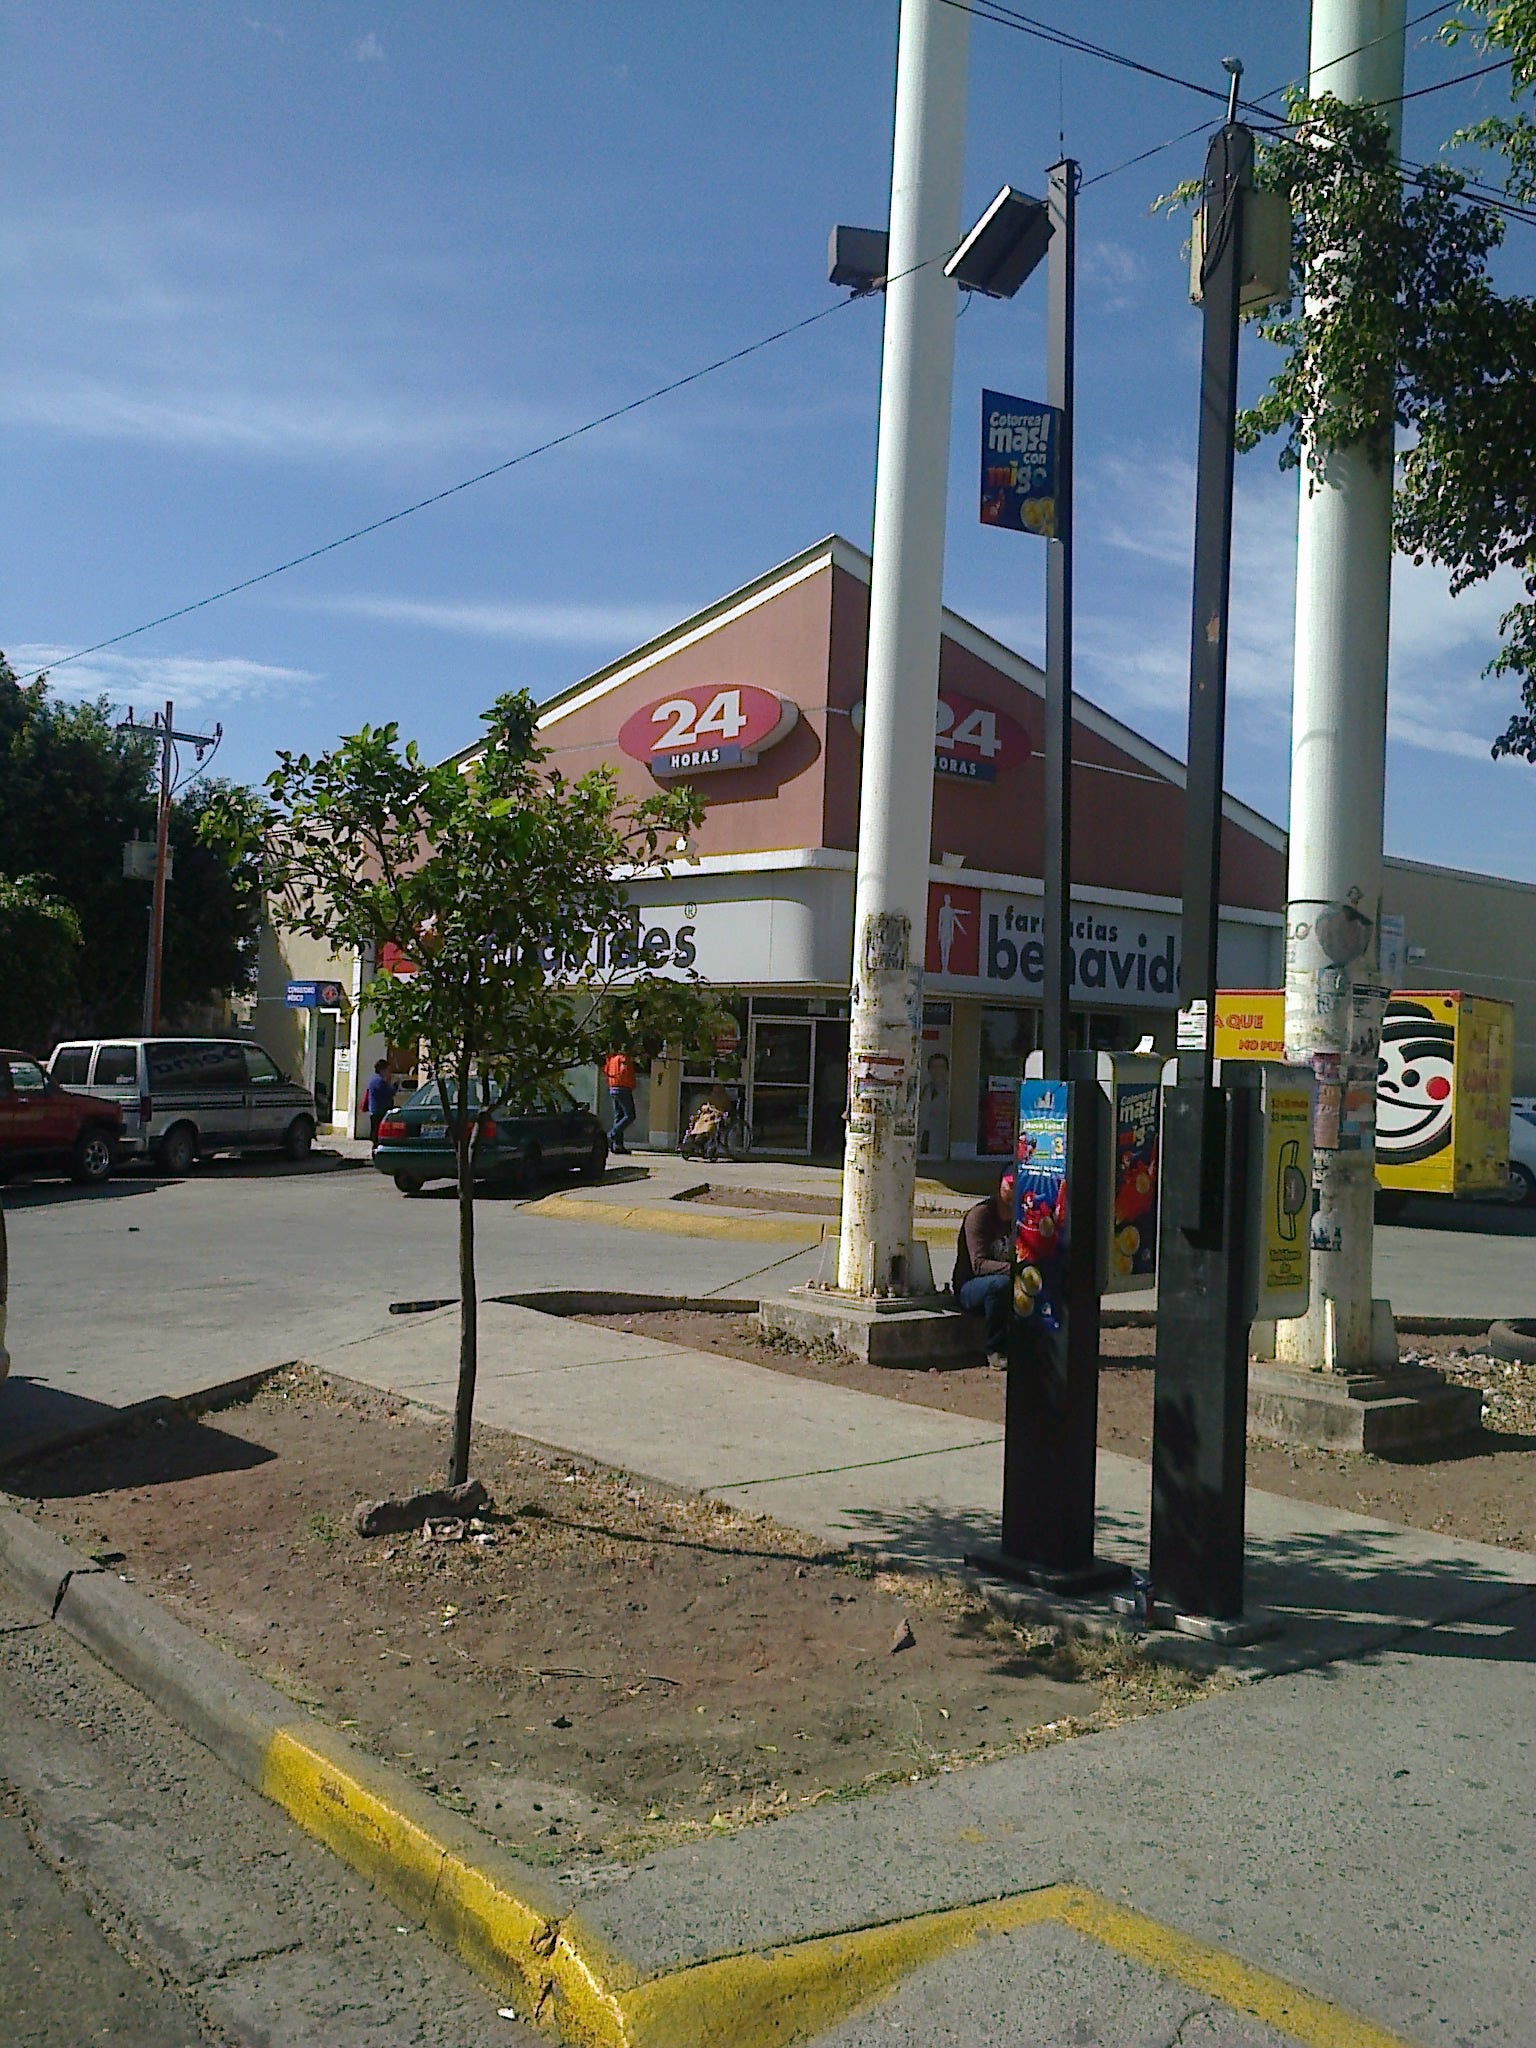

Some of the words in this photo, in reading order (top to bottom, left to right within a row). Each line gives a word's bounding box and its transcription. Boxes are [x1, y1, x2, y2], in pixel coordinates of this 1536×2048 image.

[988, 413, 1051, 453] mas!
[1023, 453, 1047, 465] con
[650, 689, 747, 751] 24
[670, 748, 720, 768] HORAS
[936, 757, 977, 776] ORAS
[1004, 905, 1119, 943] farcias
[986, 914, 1182, 994] beavid
[1226, 1014, 1264, 1030] QUE
[1238, 1039, 1258, 1051] NO
